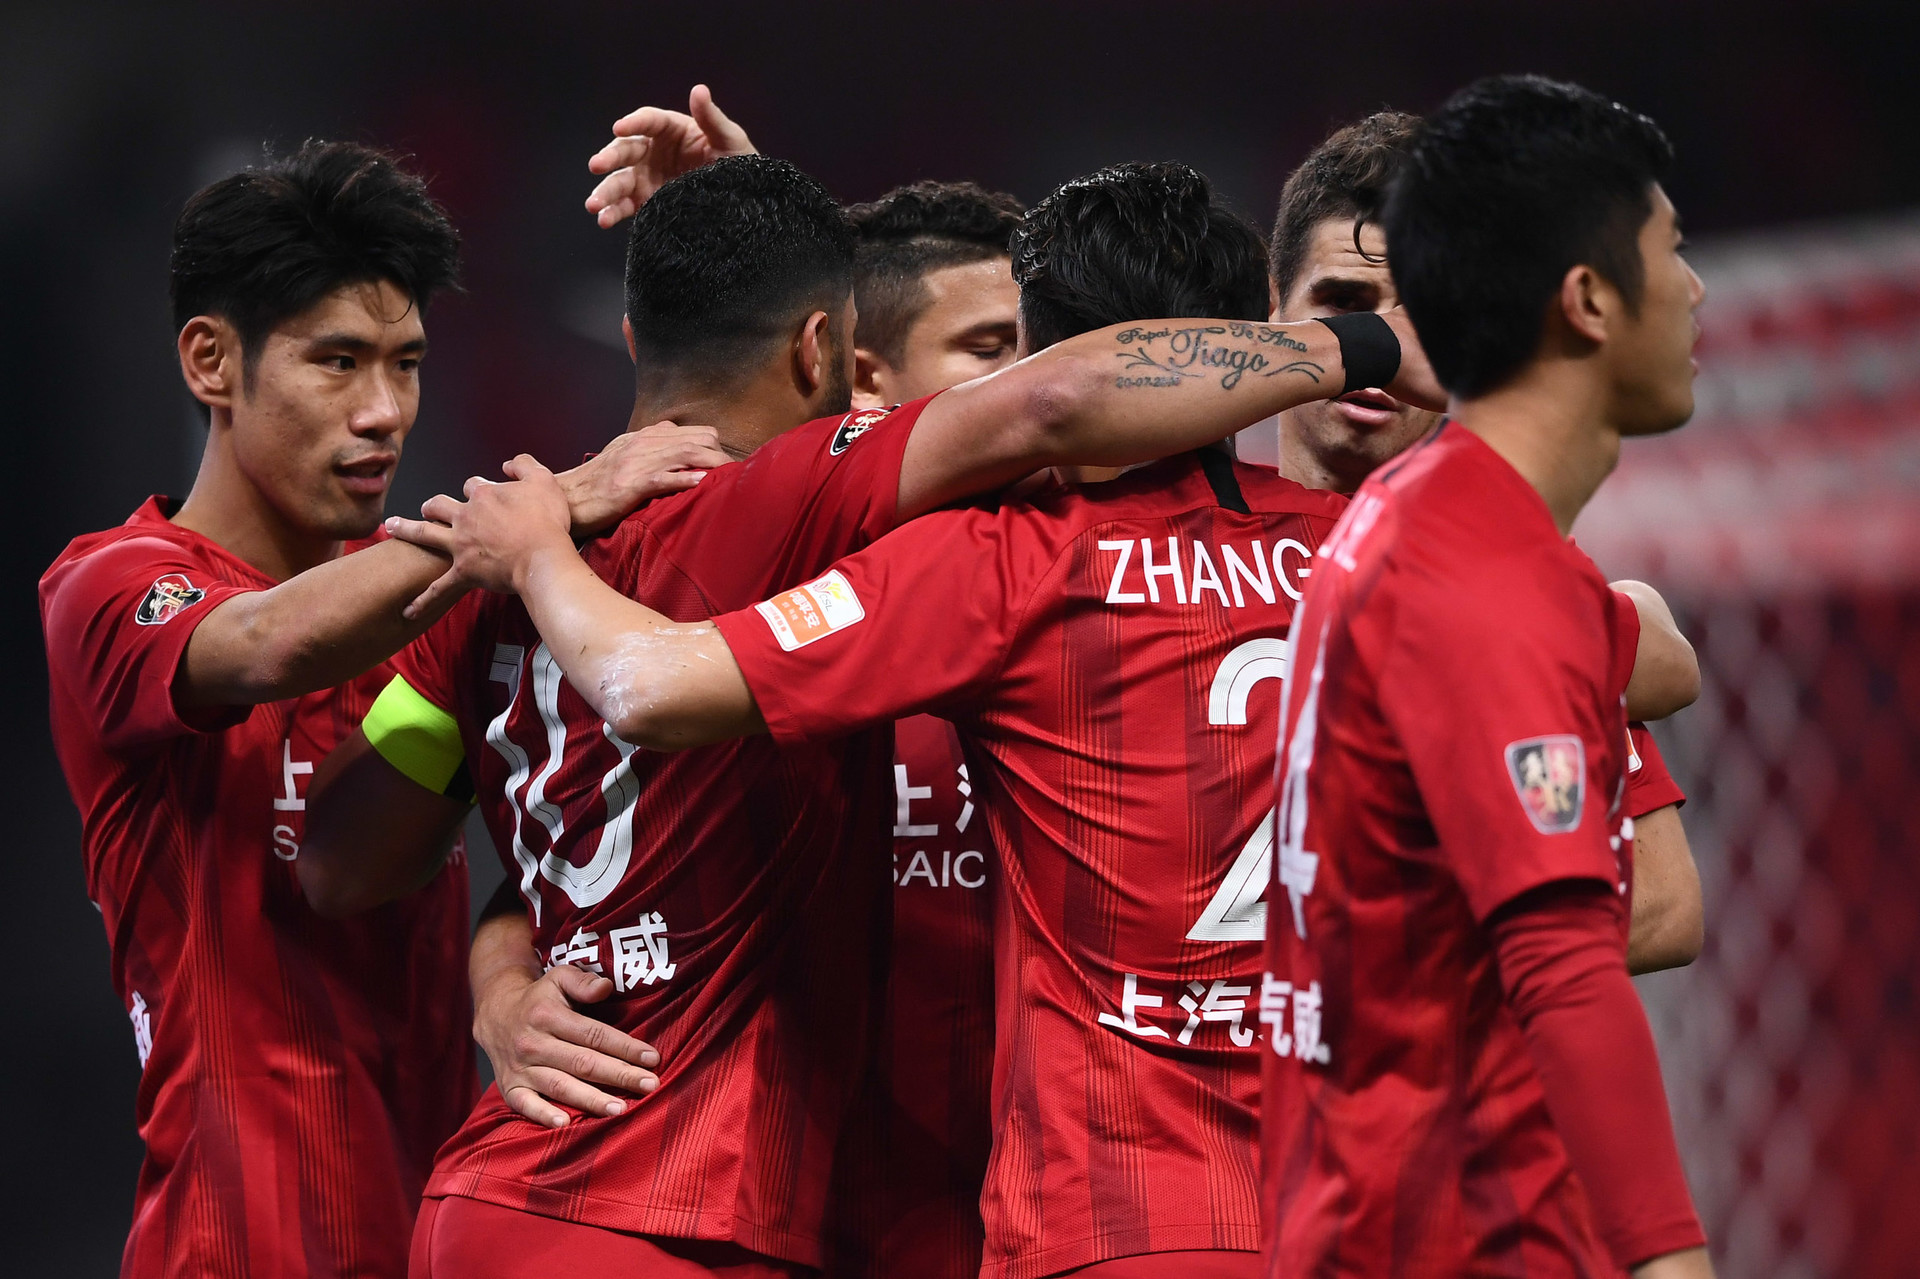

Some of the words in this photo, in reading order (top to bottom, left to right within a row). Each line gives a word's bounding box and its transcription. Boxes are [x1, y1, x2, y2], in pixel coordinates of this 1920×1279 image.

[1168, 326, 1269, 390] Tiago
[1257, 327, 1307, 352] Ama
[1098, 537, 1313, 608] ZHANG
[893, 763, 975, 837] 上
